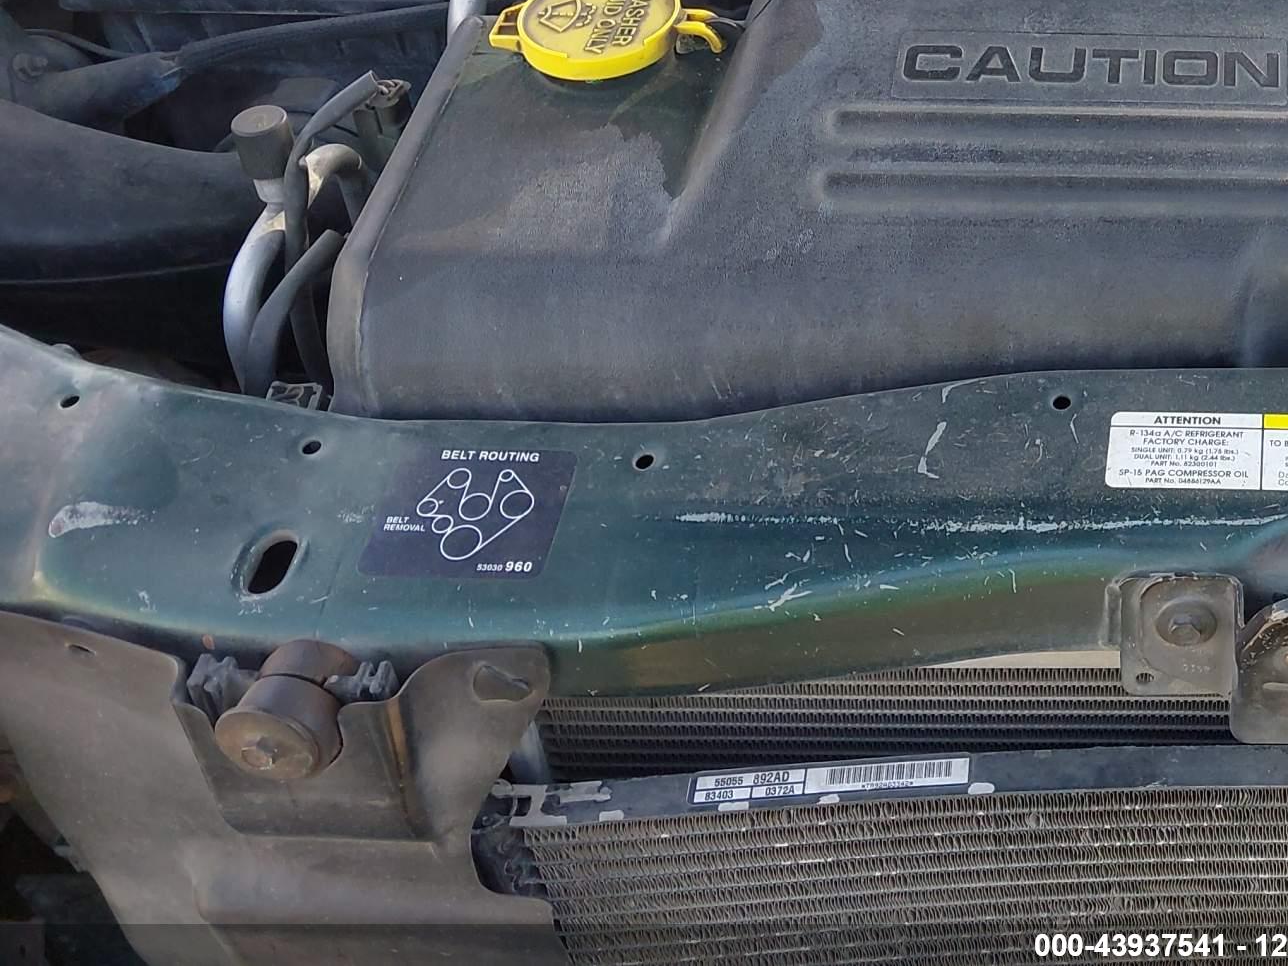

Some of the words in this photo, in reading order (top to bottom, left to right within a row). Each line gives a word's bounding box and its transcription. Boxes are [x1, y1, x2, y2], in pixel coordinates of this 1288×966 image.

[584, 18, 617, 54] ONLY
[902, 44, 1281, 88] CAUTION
[1154, 416, 1221, 425] ATTENTION
[1129, 429, 1161, 437] R-134a
[1185, 430, 1244, 438] REFRIGERANT
[1143, 437, 1185, 445] FACTORY
[1188, 438, 1229, 446] CHARGE:
[1269, 439, 1281, 447] TO
[441, 450, 476, 460] BELT
[479, 450, 540, 462] ROUTING
[1168, 469, 1232, 478] COMPRESSOR
[383, 523, 426, 532] REMOVAL
[476, 563, 503, 572] 53030
[505, 561, 533, 573] 960
[714, 776, 744, 787] 55055
[753, 771, 790, 785] 892AD
[704, 789, 734, 801] 83403
[765, 785, 795, 797] 0372A
